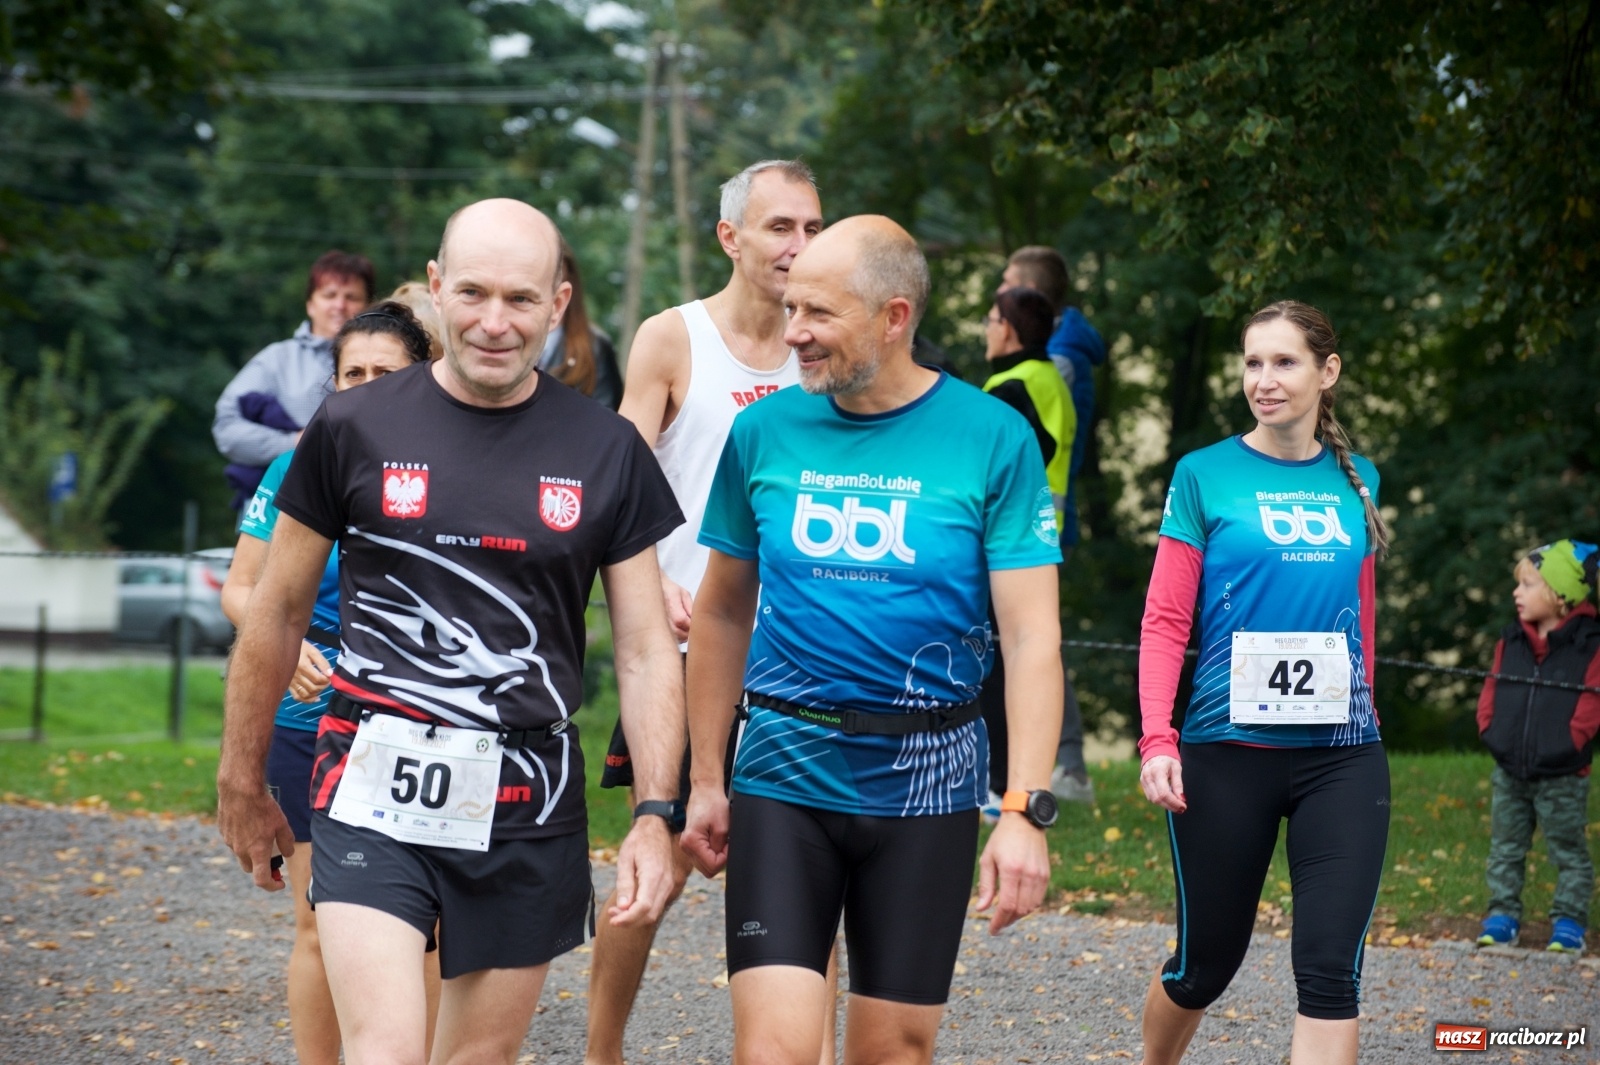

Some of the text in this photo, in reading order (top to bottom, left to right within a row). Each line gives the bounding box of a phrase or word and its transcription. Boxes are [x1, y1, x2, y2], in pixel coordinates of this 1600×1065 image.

[383, 461, 429, 471] POLSKA
[540, 475, 583, 488] RACIBÓRZ
[800, 470, 922, 494] BiegamBoLubię
[246, 493, 268, 524] bl
[1256, 490, 1340, 503] BiegamBoLubię
[791, 493, 916, 565] bbl
[1259, 505, 1352, 546] bbl
[1281, 550, 1336, 562] RACIBÓRZ
[812, 567, 890, 583] RACIBÓRZ
[1268, 659, 1315, 696] 42
[391, 756, 452, 809] 50
